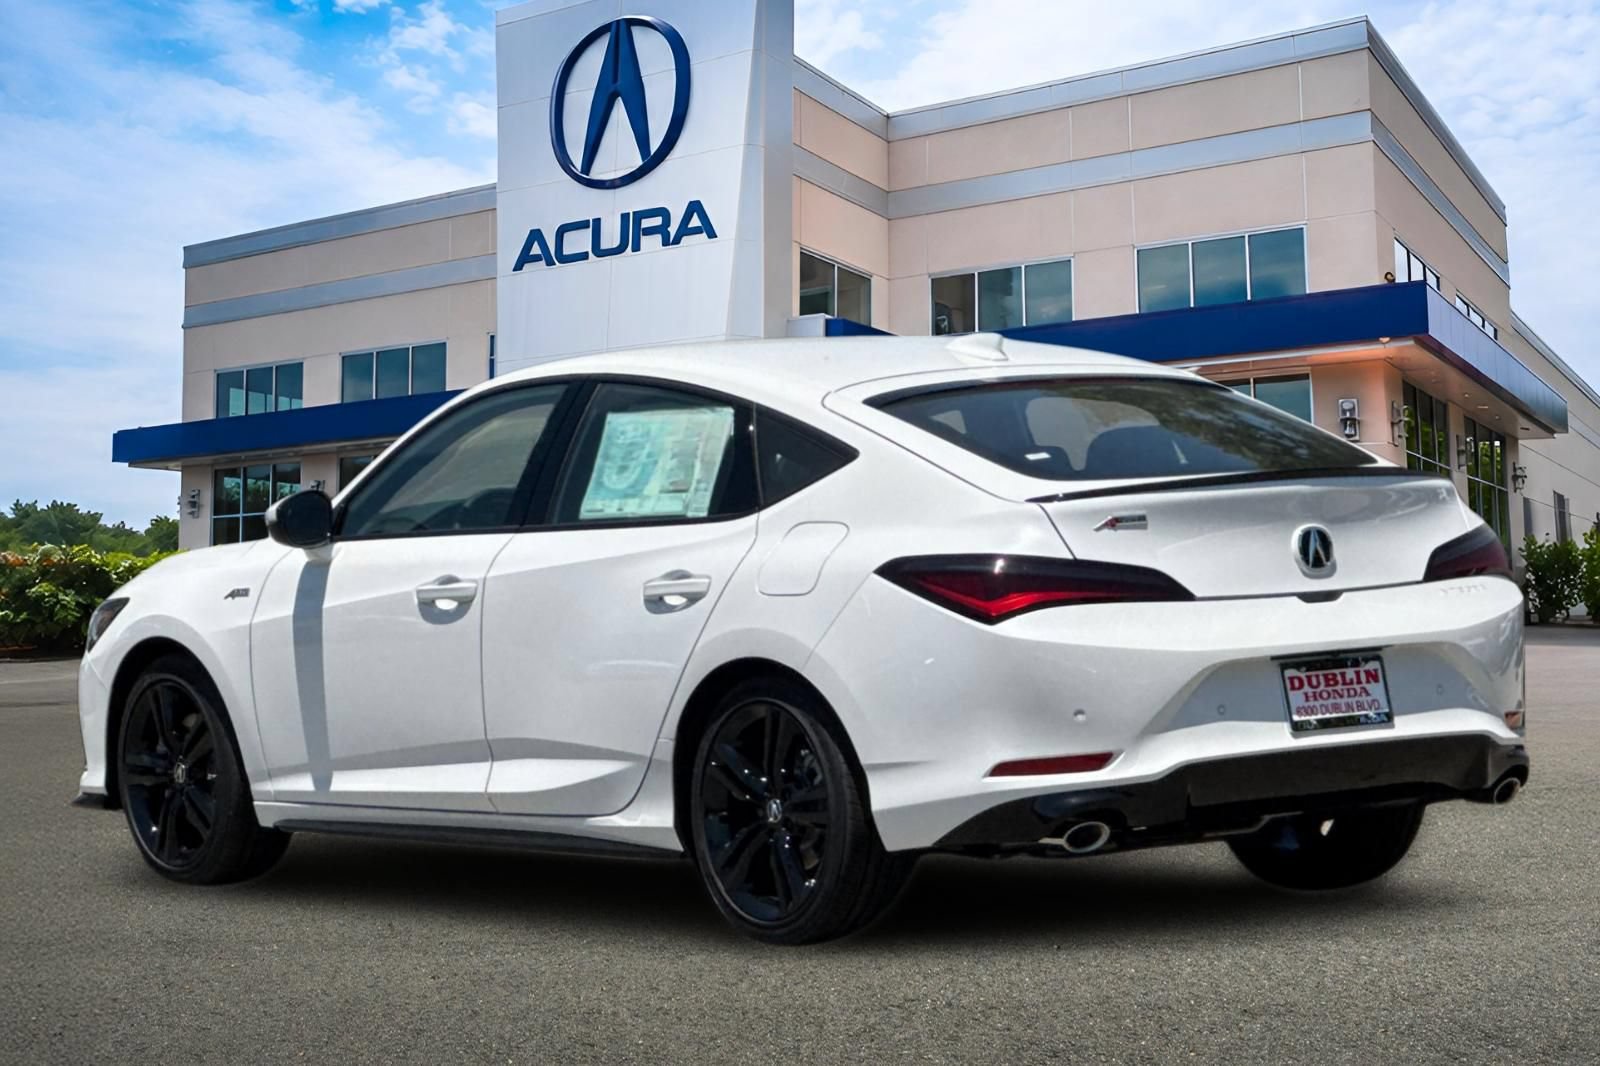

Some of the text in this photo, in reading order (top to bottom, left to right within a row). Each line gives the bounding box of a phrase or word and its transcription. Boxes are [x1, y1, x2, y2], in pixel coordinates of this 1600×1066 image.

[512, 199, 718, 272] ACURA
[1287, 668, 1380, 691] DUBLIN
[1304, 686, 1371, 702] HONDA
[1319, 701, 1355, 716] DUBLIN
